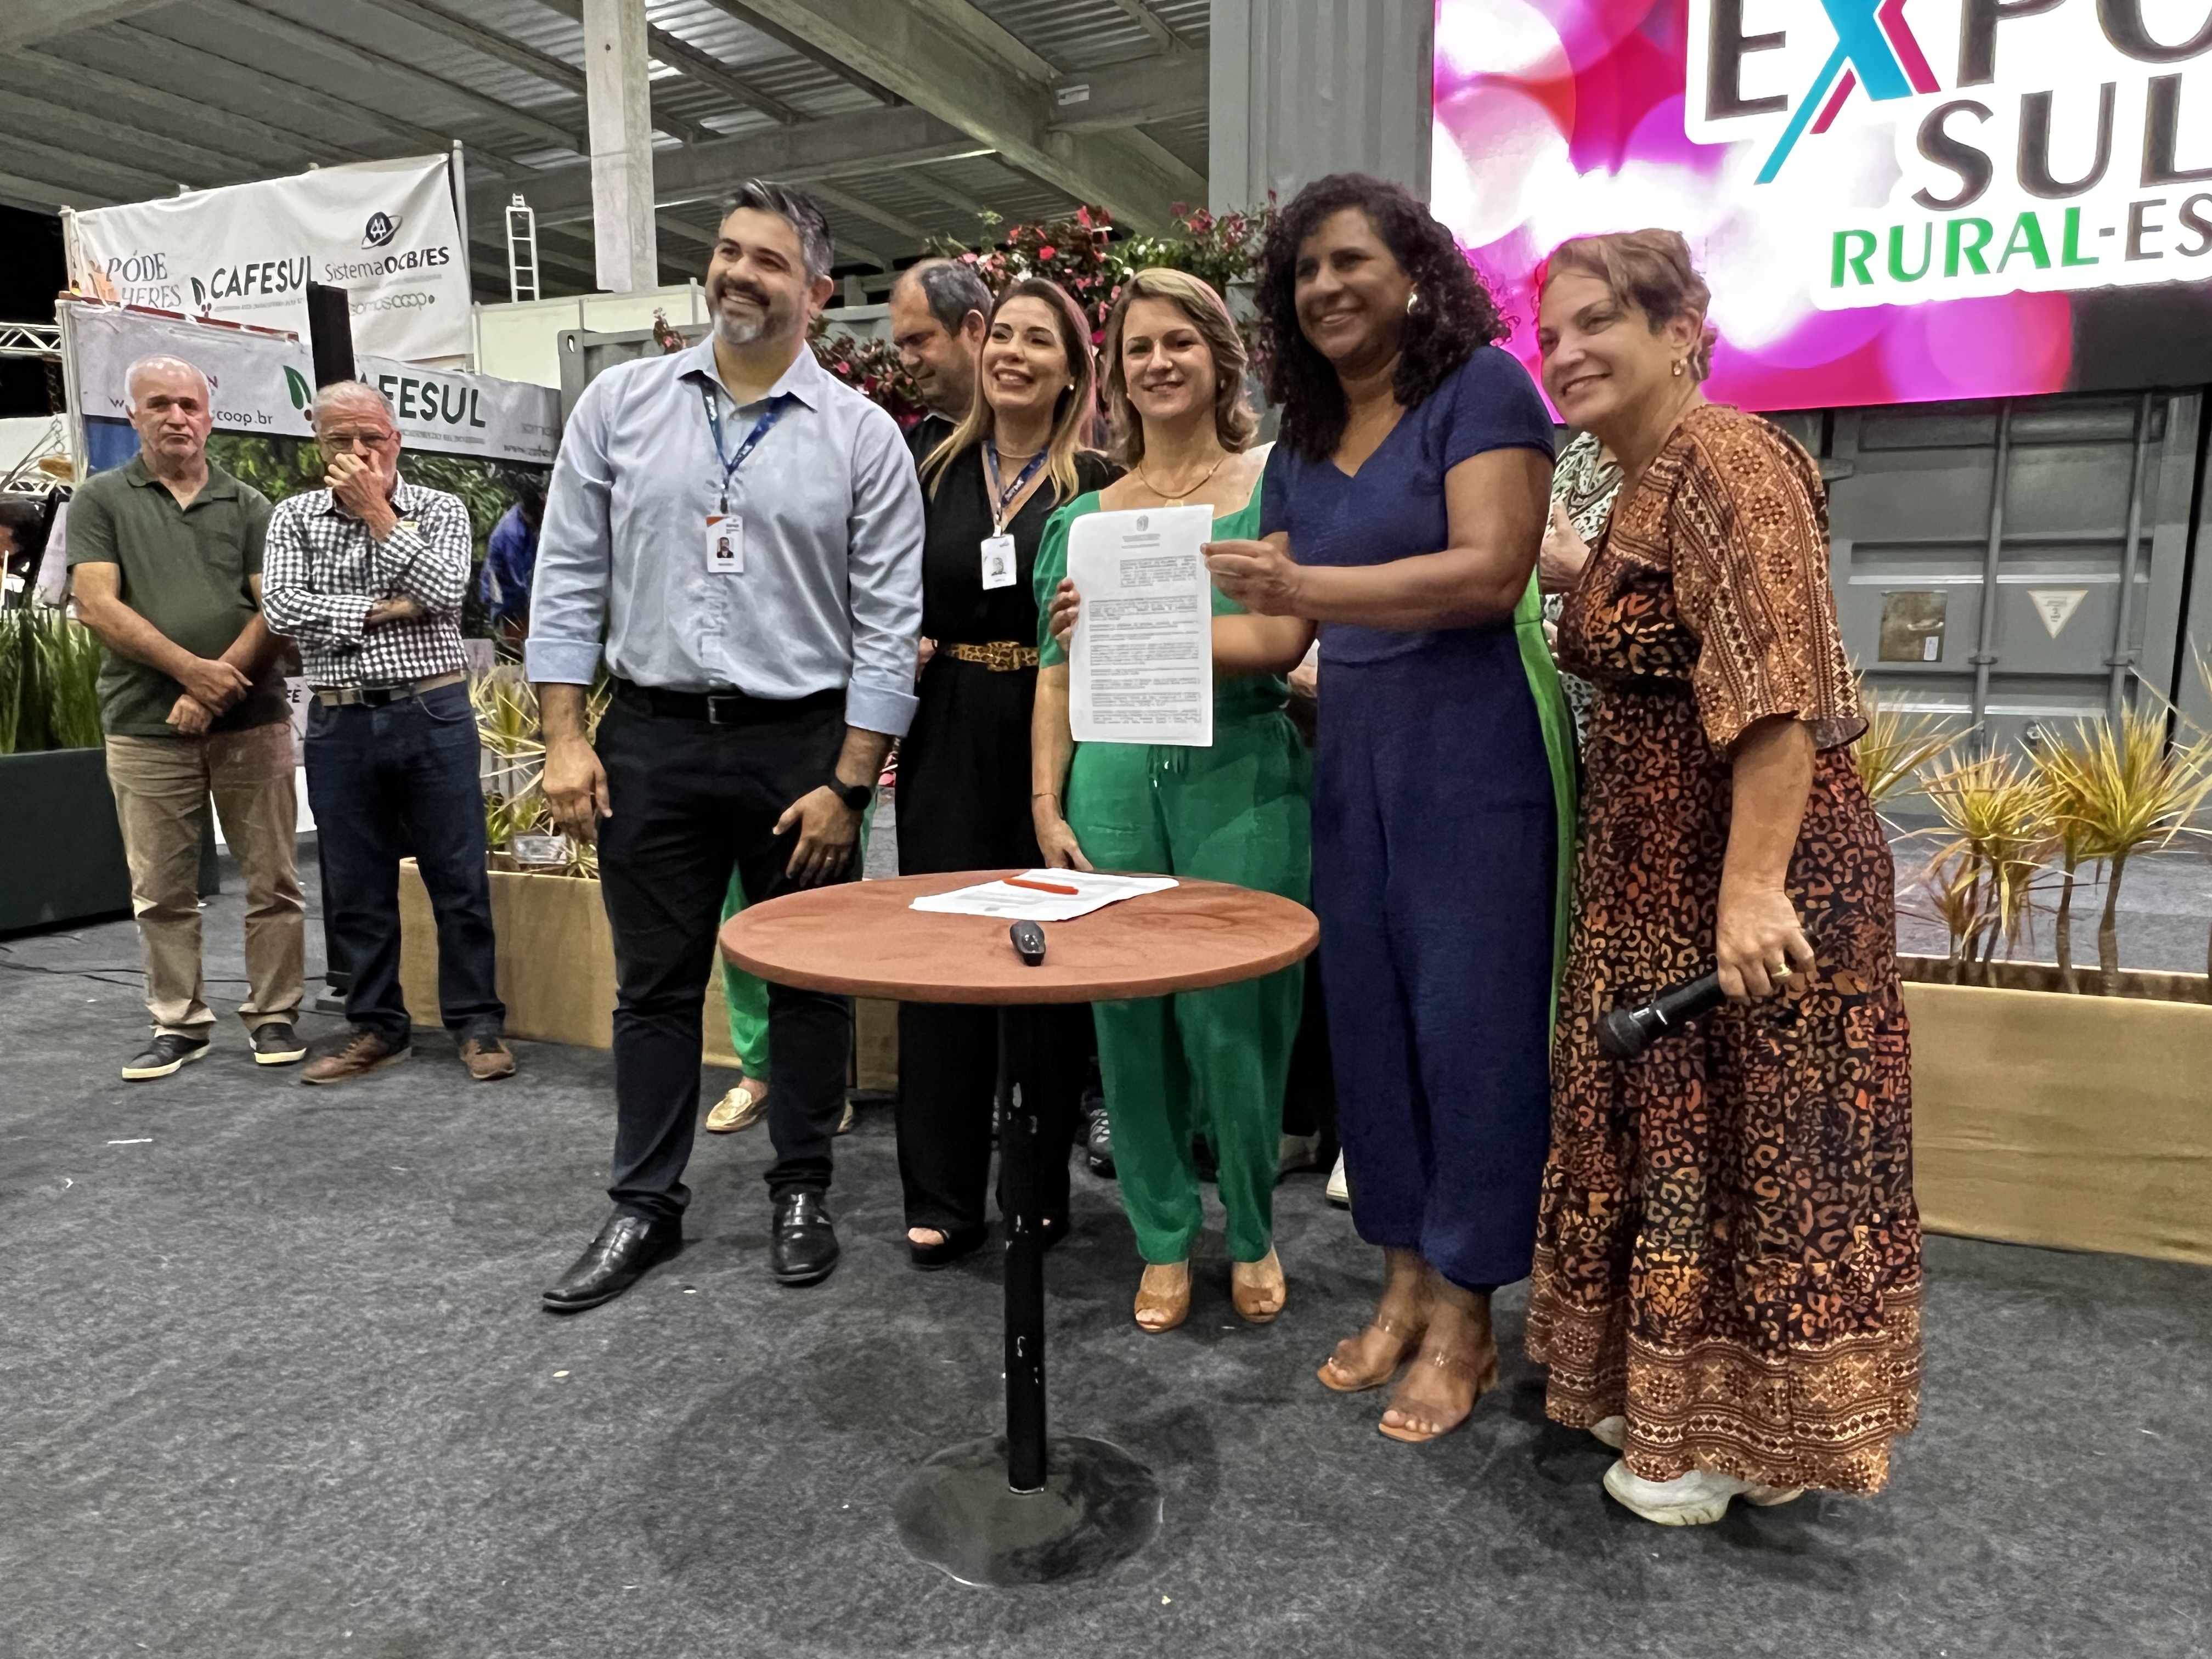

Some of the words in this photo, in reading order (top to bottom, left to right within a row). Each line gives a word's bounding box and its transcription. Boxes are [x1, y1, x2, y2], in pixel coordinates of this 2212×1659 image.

[1911, 73, 2212, 211] SUL
[211, 256, 312, 299] CAFESUL
[360, 373, 486, 428] FESUL
